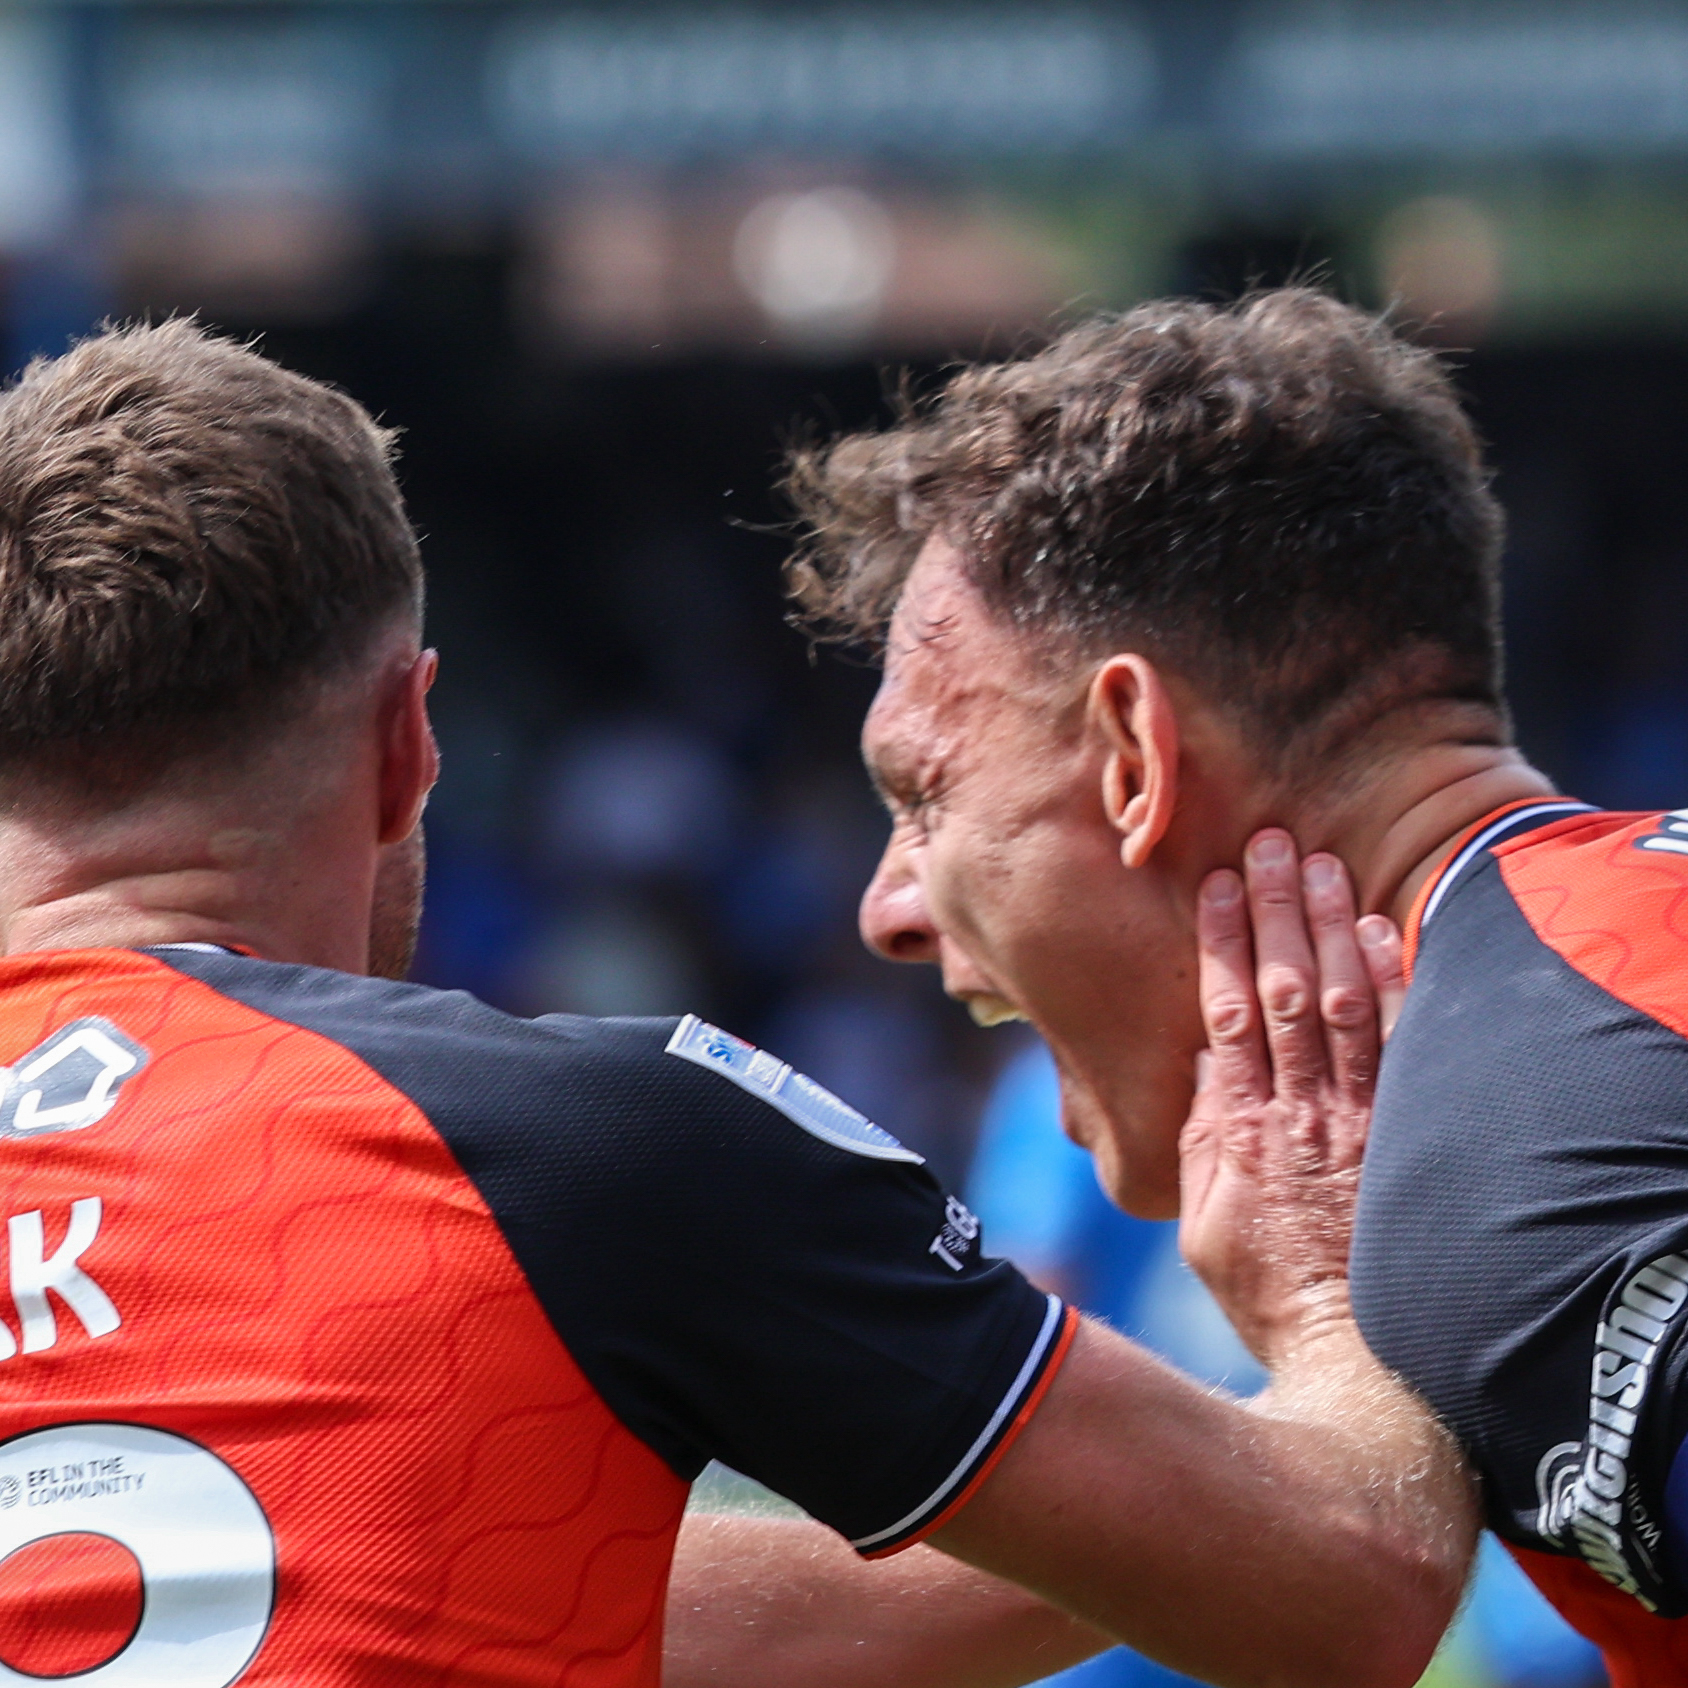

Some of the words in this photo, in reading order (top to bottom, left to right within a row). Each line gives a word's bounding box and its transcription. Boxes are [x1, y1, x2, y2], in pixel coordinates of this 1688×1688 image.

[26, 1466, 60, 1488] EFL
[86, 1455, 125, 1478] THE
[27, 1471, 147, 1507] COMMUNITY
